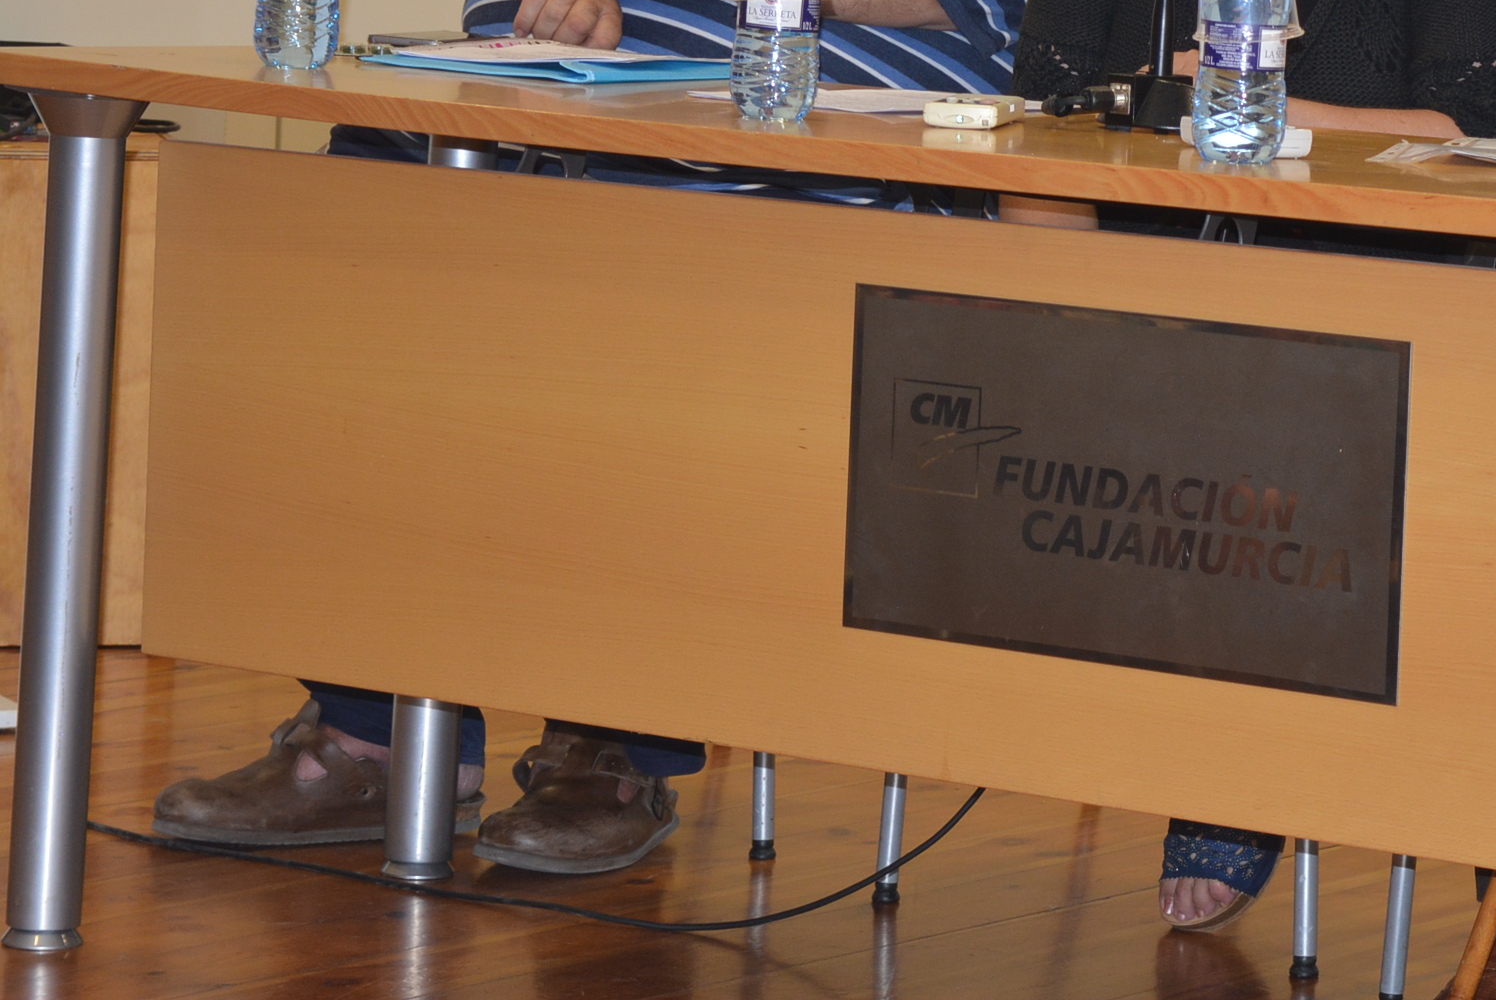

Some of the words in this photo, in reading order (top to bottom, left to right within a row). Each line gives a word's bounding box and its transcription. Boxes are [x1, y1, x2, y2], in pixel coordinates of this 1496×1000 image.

[748, 6, 757, 16] LA
[909, 391, 973, 430] CM
[992, 454, 1299, 534] FUNDACIÓN
[1020, 509, 1354, 593] CAJAMURCIA
